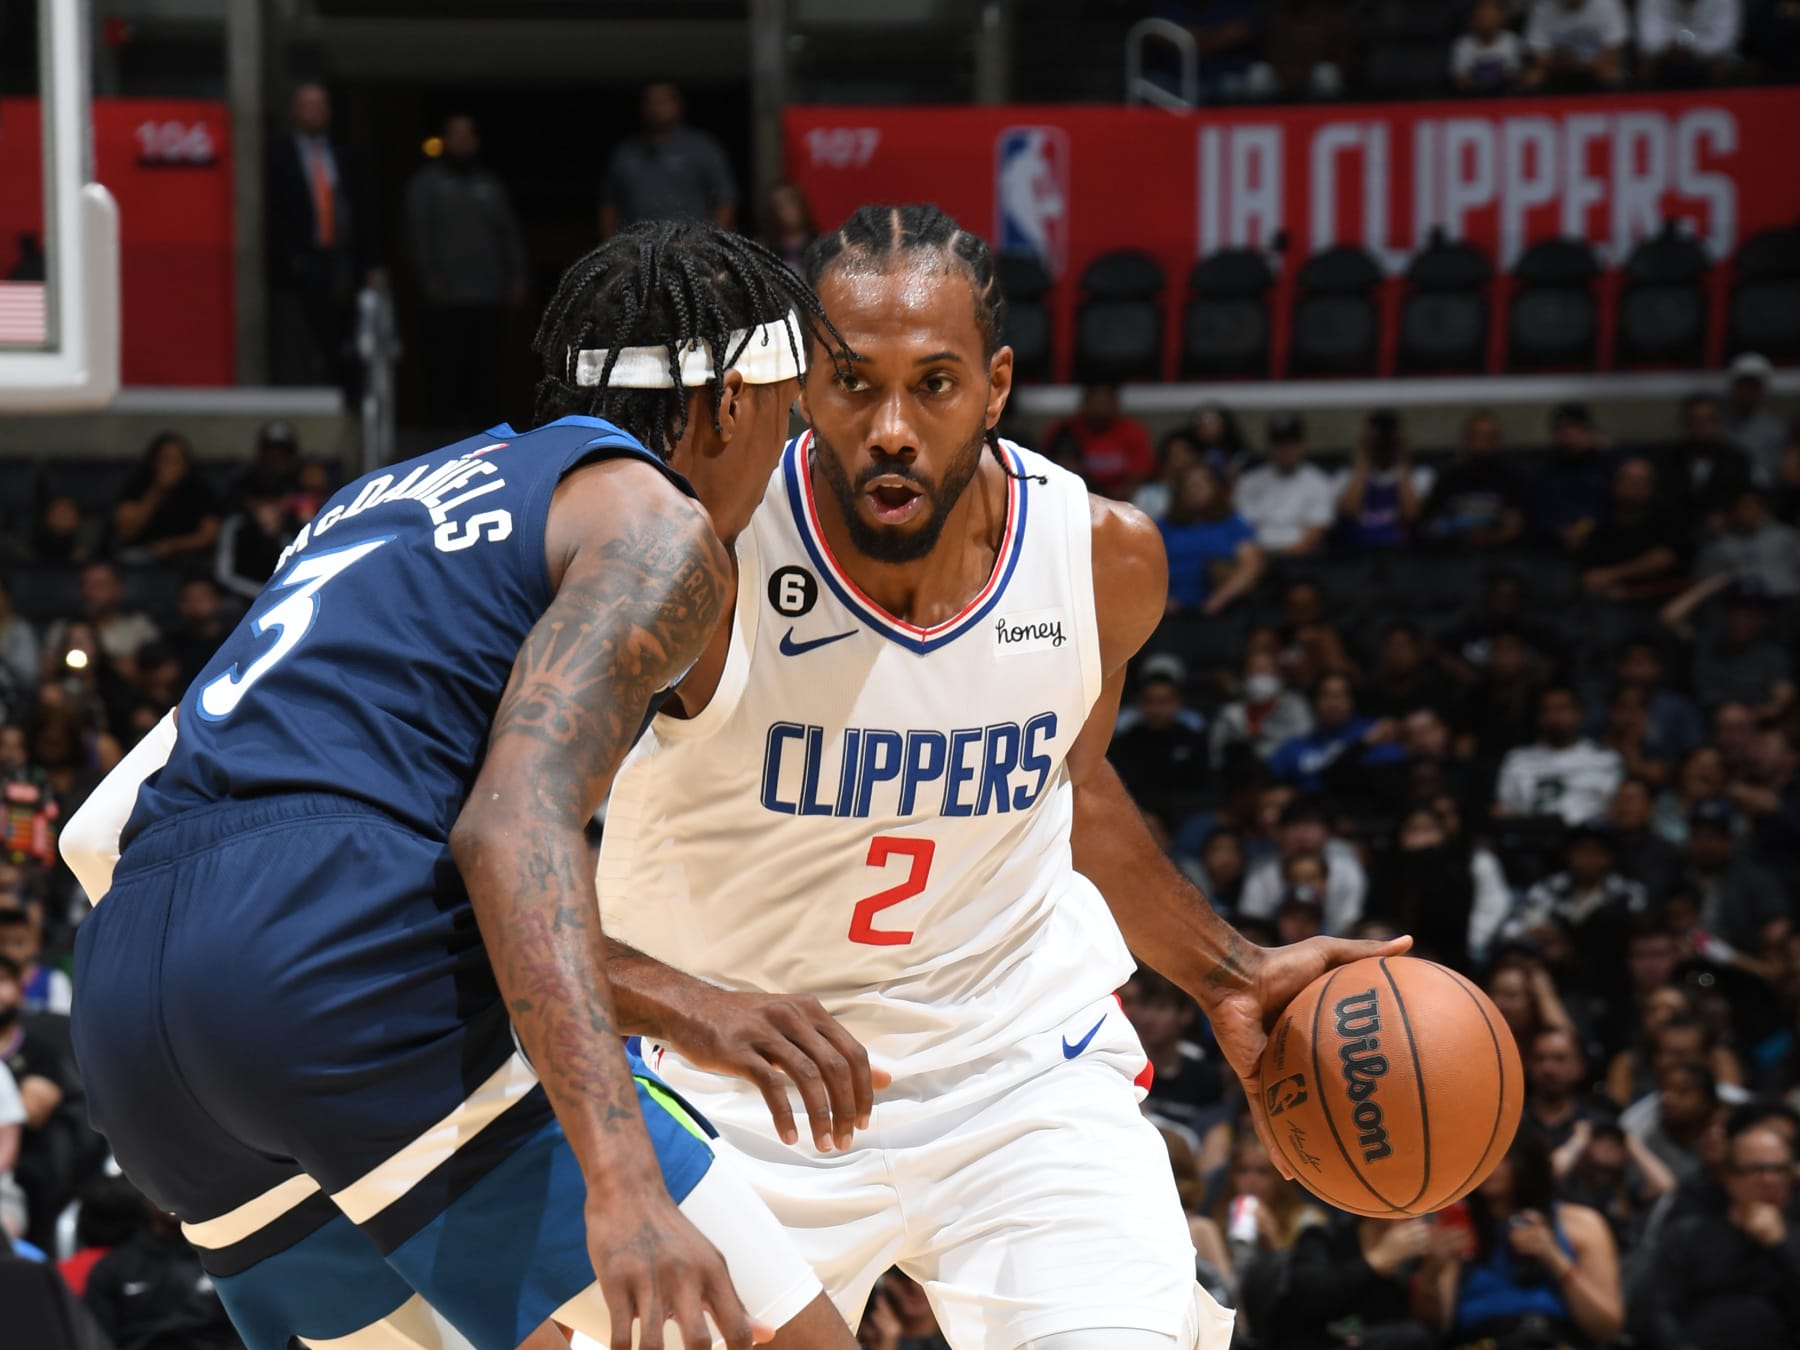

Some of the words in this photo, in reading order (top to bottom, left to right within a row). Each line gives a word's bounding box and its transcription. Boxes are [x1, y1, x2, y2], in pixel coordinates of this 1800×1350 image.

[804, 127, 882, 168] 107
[196, 535, 397, 722] 3
[779, 573, 806, 611] 6
[995, 618, 1067, 647] honey
[760, 711, 1058, 817] CLIPPERS
[848, 836, 936, 946] 2
[1334, 988, 1393, 1165] Wilson
